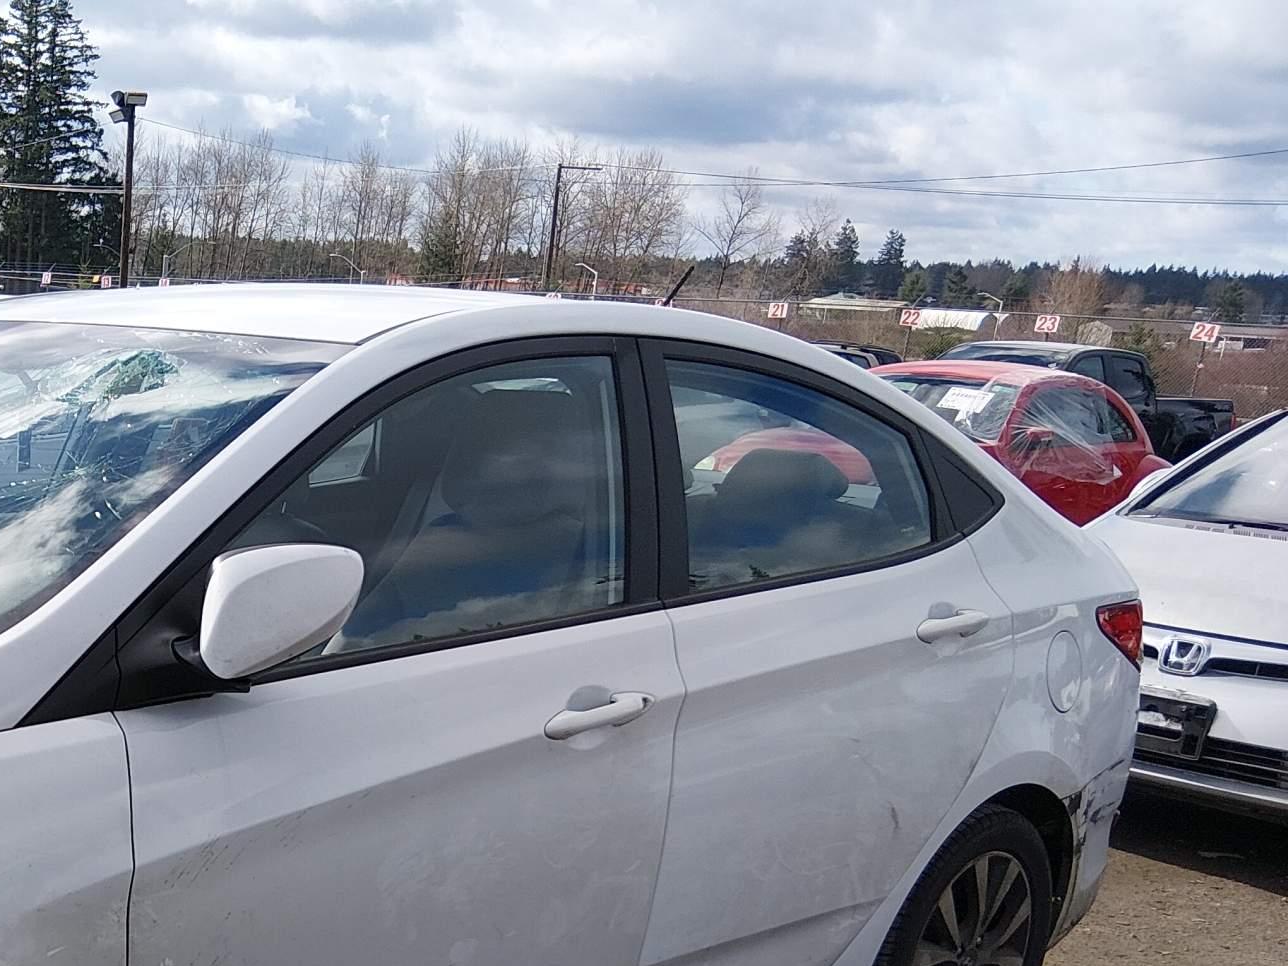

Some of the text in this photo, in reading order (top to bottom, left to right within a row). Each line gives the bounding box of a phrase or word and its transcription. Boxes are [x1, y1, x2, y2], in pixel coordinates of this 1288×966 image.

[771, 303, 785, 317] 21
[902, 311, 920, 324] 22
[1036, 316, 1057, 331] 23
[1192, 324, 1215, 340] 24
